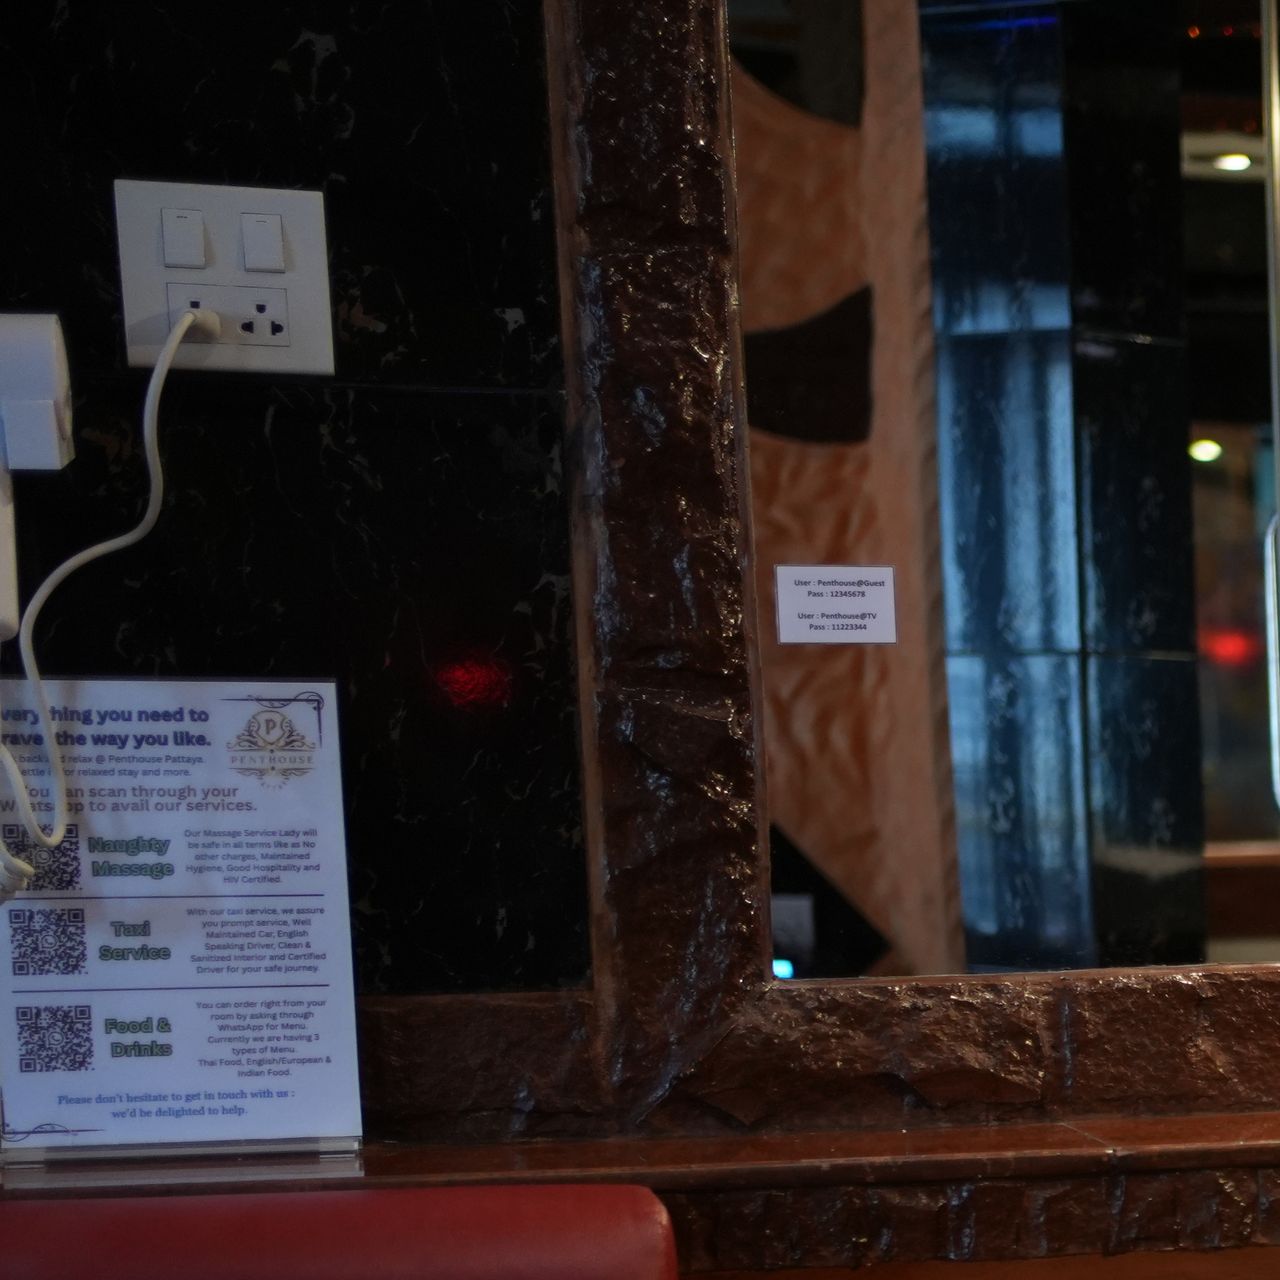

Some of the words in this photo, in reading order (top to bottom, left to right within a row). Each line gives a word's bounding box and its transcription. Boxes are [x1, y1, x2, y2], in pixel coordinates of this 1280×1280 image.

[818, 579, 885, 587] Penthouse@Guest
[821, 612, 877, 620] Penthouse@TV
[0, 706, 93, 725] veryhing
[96, 709, 132, 725] you
[137, 706, 184, 721] need
[188, 708, 209, 721] to
[0, 733, 44, 746] rave
[55, 731, 87, 746] the
[91, 733, 129, 749] way
[132, 734, 169, 749] you
[173, 731, 211, 746] like.
[69, 754, 92, 762] relax
[95, 755, 105, 764] @
[109, 755, 162, 763] Penthouse
[231, 755, 314, 764] PENTHOUSE
[118, 769, 139, 778] stay
[26, 785, 50, 797] ou
[65, 787, 84, 798] an
[90, 786, 127, 797] scan
[132, 785, 198, 801] through
[202, 786, 239, 801] your
[90, 800, 106, 811] to
[111, 799, 150, 811] avail
[154, 801, 181, 811] our
[186, 798, 258, 811] services.
[184, 830, 201, 838] Our
[204, 830, 242, 838] Massage
[280, 829, 300, 839] Lady
[303, 829, 317, 837] will
[88, 836, 170, 856] Naughty
[188, 841, 199, 849] be
[201, 841, 222, 849] safe
[223, 841, 231, 849] in
[233, 840, 244, 849] all
[246, 841, 271, 849] terms
[274, 840, 288, 848] like
[194, 852, 219, 860] other
[221, 853, 258, 862] charges,
[260, 852, 310, 860] Maintained
[92, 860, 175, 880] Massage
[186, 863, 224, 874] Hygiene,
[226, 864, 251, 872] Good
[253, 863, 302, 873] Hospitality
[304, 863, 320, 871] and
[223, 875, 239, 883] HIV
[186, 908, 207, 917] With
[227, 908, 243, 916] taxi
[245, 908, 280, 917] service,
[110, 920, 151, 937] Taxi
[202, 920, 218, 929] you
[221, 920, 254, 929] prompt
[256, 919, 290, 927] service,
[292, 918, 311, 926] Well
[206, 930, 256, 939] Maintained
[258, 930, 275, 939] Car,
[277, 930, 309, 939] English
[204, 942, 245, 951] Speaking
[247, 942, 276, 951] Driver,
[278, 941, 303, 949] Clean
[99, 944, 171, 961] Service
[191, 953, 232, 962] Sanitized
[234, 953, 267, 961] Interior
[269, 952, 285, 961] and
[287, 952, 327, 960] Certified
[196, 965, 223, 974] Driver
[226, 965, 239, 973] for
[241, 965, 262, 975] your
[264, 964, 282, 972] safe
[196, 1001, 213, 1009] You
[260, 1000, 282, 1009] right
[306, 1000, 326, 1008] your
[236, 1012, 248, 1021] by
[250, 1012, 277, 1021] asking
[279, 1011, 315, 1020] through
[104, 1017, 154, 1034] Food
[156, 1017, 172, 1033] &
[217, 1023, 263, 1032] WhatsApp
[281, 1022, 306, 1030] Menu.
[207, 1035, 250, 1045] Currently
[283, 1034, 313, 1043] having
[111, 1041, 172, 1058] Drinks
[232, 1046, 257, 1056] types
[259, 1046, 268, 1054] of
[198, 1059, 217, 1067] Thai
[219, 1058, 245, 1067] Food,
[247, 1057, 323, 1067] English/European
[325, 1056, 332, 1064] &
[237, 1069, 265, 1077] Indian
[267, 1068, 292, 1077] Food.
[57, 1094, 92, 1105] Please
[95, 1093, 123, 1105] don't
[126, 1092, 169, 1103] hesitate
[171, 1093, 183, 1102] to
[185, 1093, 202, 1103] get
[203, 1091, 215, 1100] in
[218, 1090, 247, 1100] touch
[250, 1089, 273, 1099] with
[276, 1090, 289, 1098] us
[111, 1108, 137, 1119] we'd
[140, 1108, 153, 1118] be
[155, 1107, 205, 1120] delighted
[208, 1107, 219, 1116] to
[221, 1105, 248, 1117] help.
